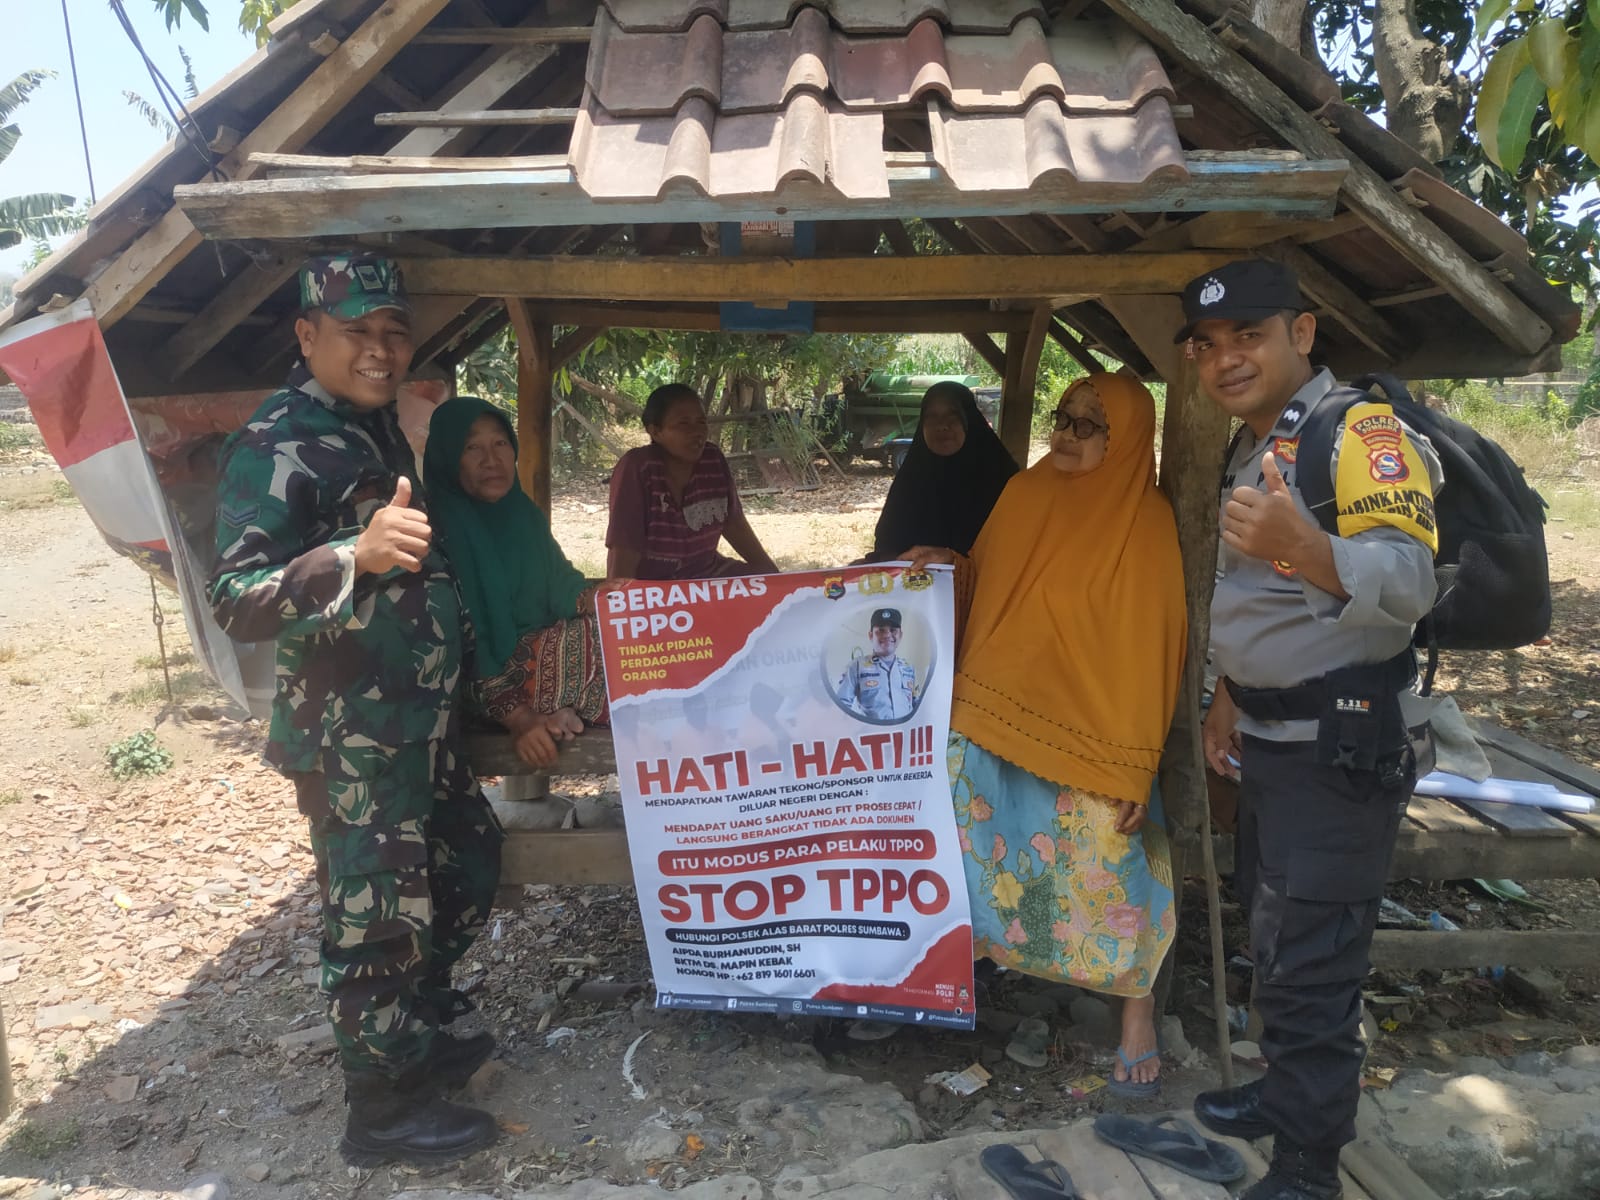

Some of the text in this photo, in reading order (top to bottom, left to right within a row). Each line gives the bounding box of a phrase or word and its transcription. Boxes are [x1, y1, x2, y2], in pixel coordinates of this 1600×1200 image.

[1355, 416, 1399, 430] POLRES
[607, 577, 768, 613] BERANTAS
[609, 610, 694, 640] TPPO
[618, 636, 713, 656] TINDAK PIDANA
[620, 649, 713, 669] PERDAGANGAN
[622, 669, 667, 682] ORANG
[636, 750, 750, 796] HATI
[761, 762, 782, 774] -
[644, 770, 934, 808] MENDAPATKAN TAWARAN TEKONG/SPONSOR UNTUK BEKERJA
[738, 800, 777, 813] DILUAR
[779, 794, 817, 806] NEGERI
[819, 788, 863, 801] DENGAN
[664, 822, 727, 833] MENDAPAT
[729, 817, 763, 829] UANG
[765, 807, 833, 824] SAKU/UANG
[835, 804, 853, 814] FIT
[855, 802, 893, 812] PROSES
[893, 801, 917, 811] CEPAT
[676, 815, 915, 845] LANGSUNG BERANGKAT TIDAK ADA DOKUMEN
[672, 838, 925, 870] ITU MODUS PARA PELAKU TPPO
[658, 868, 951, 924] STOP TPPO
[675, 932, 720, 942] HUBUNGI
[721, 929, 760, 941] POLSEK
[762, 926, 788, 937] ALAS
[789, 924, 822, 935] BARAT
[823, 923, 857, 934] POLRES
[672, 943, 801, 959] AIPDA BURHANUDDIN, SH
[673, 956, 793, 970] BKTM DS. MAPIN KEBAK
[676, 967, 716, 978] NOMOR
[716, 972, 730, 981] HP
[735, 970, 754, 981] +62
[755, 969, 771, 979] 819
[773, 968, 793, 979] 1601
[793, 967, 817, 978] 6601
